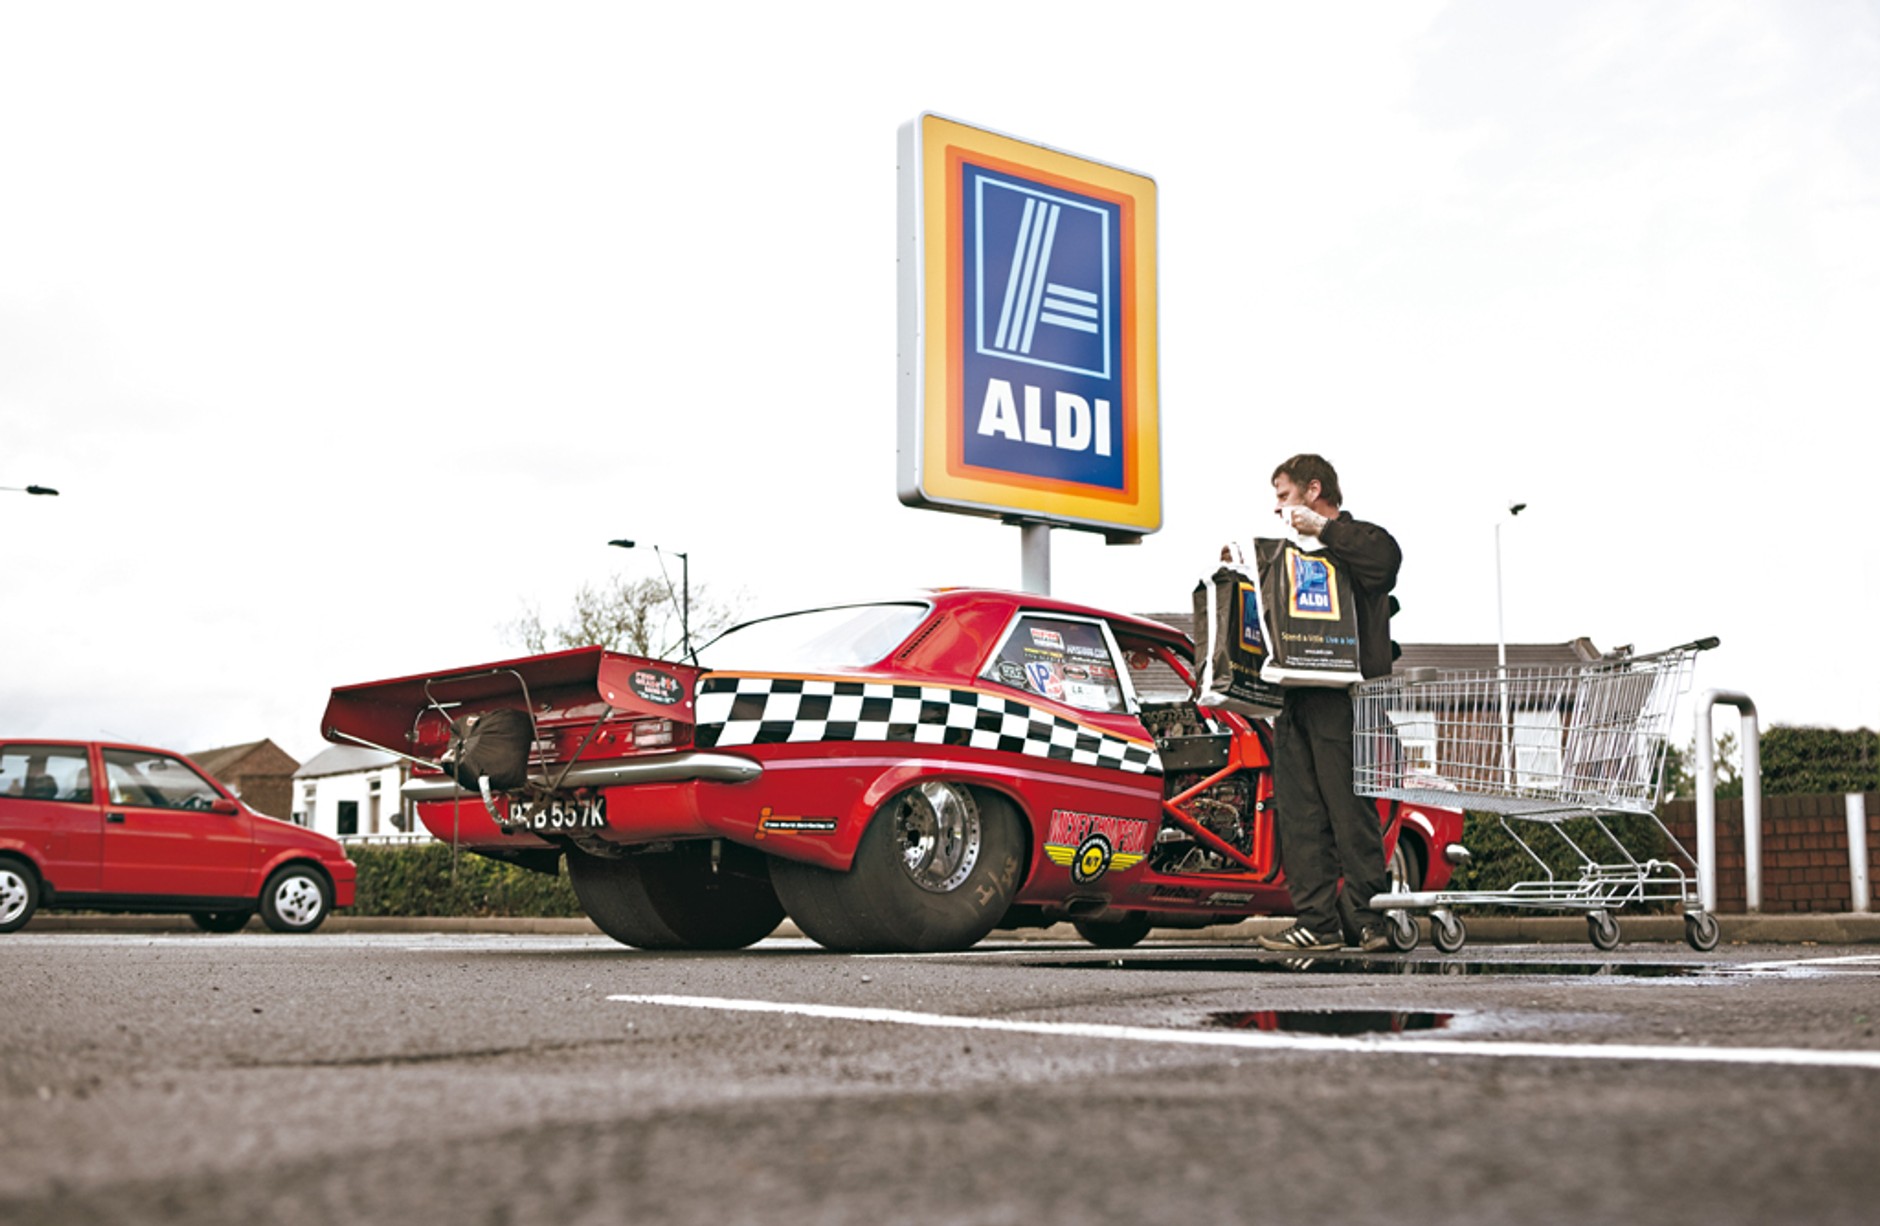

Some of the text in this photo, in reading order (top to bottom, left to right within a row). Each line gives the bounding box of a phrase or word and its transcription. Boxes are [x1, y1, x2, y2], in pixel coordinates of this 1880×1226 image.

[977, 378, 1111, 457] ALDI
[1299, 592, 1329, 607] ALDI
[1244, 626, 1261, 643] ALD
[1050, 810, 1149, 853] MICKEY THOMPSON
